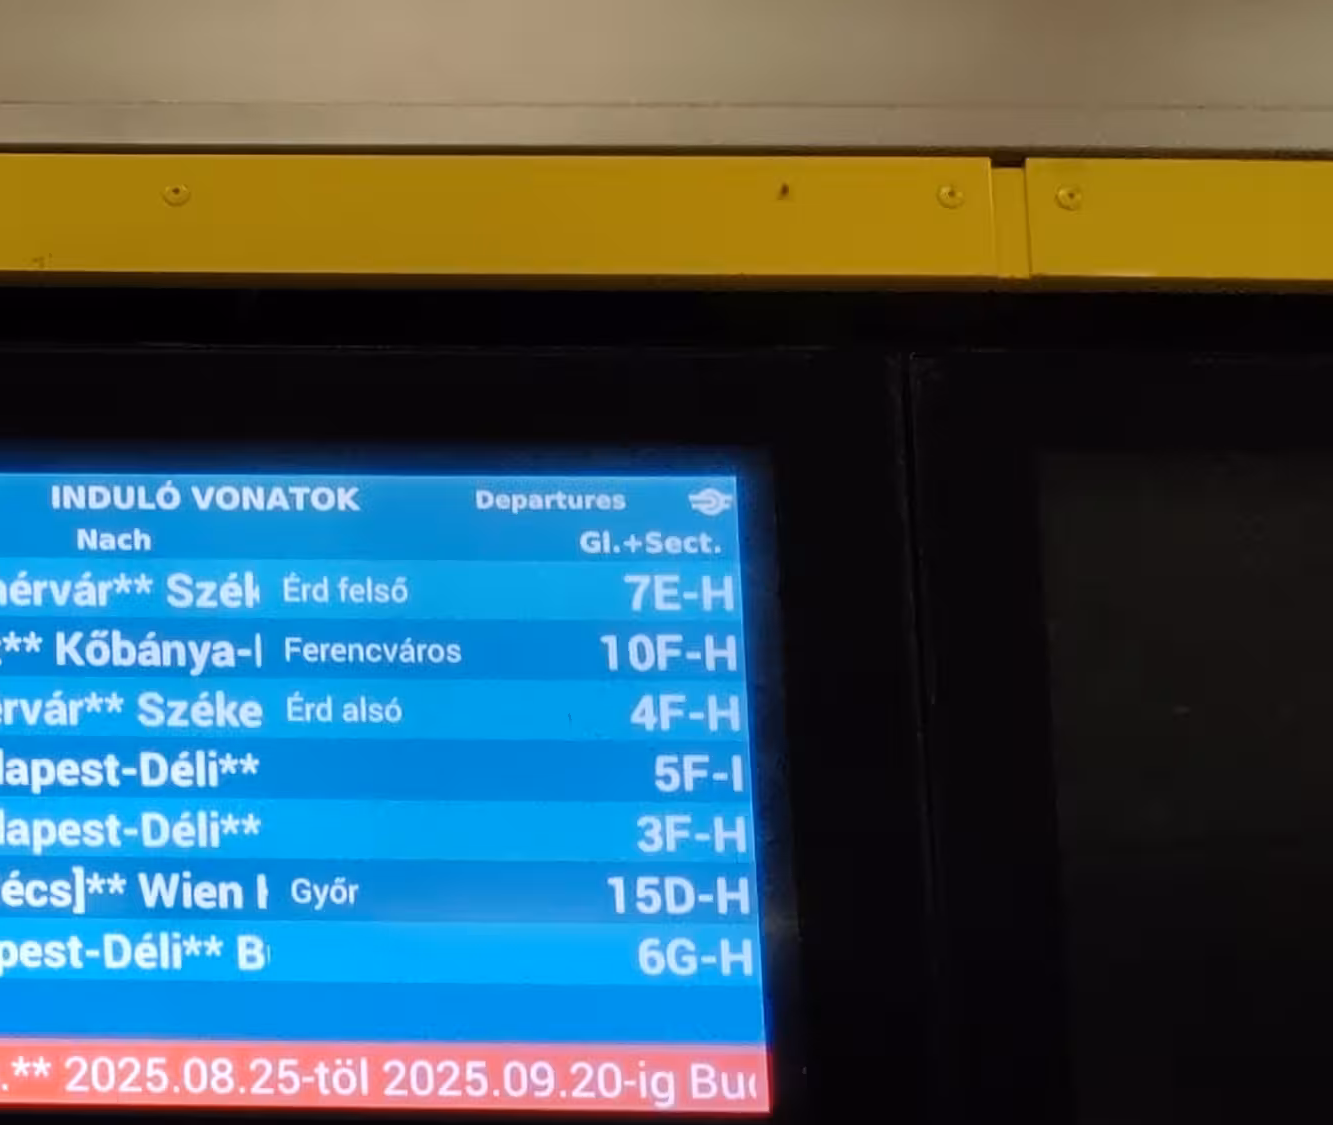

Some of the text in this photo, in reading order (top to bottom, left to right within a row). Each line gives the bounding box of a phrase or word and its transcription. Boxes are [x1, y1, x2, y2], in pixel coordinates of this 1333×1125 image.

[51, 480, 360, 512] INDULÓ VONATOK
[475, 490, 626, 514] Departures
[77, 528, 151, 551] Nach
[580, 531, 721, 555] Gl.+Sect.
[284, 571, 329, 603] Érd
[338, 577, 408, 604] felső
[624, 574, 734, 612] 7E-H
[285, 636, 462, 664] Ferencváros
[600, 634, 737, 672] 10F-H
[138, 690, 263, 729] Széke
[286, 691, 333, 723] Érd
[342, 695, 402, 723] alsó
[631, 694, 741, 732] 4F-H
[655, 755, 743, 793] 5F-I
[637, 816, 747, 853] 3F-H
[139, 871, 244, 909] Wien
[291, 877, 358, 911] Győr
[608, 876, 750, 915] 15D-H
[638, 938, 753, 976] 6G-H
[382, 1059, 675, 1109] 2025.09.20-ig
